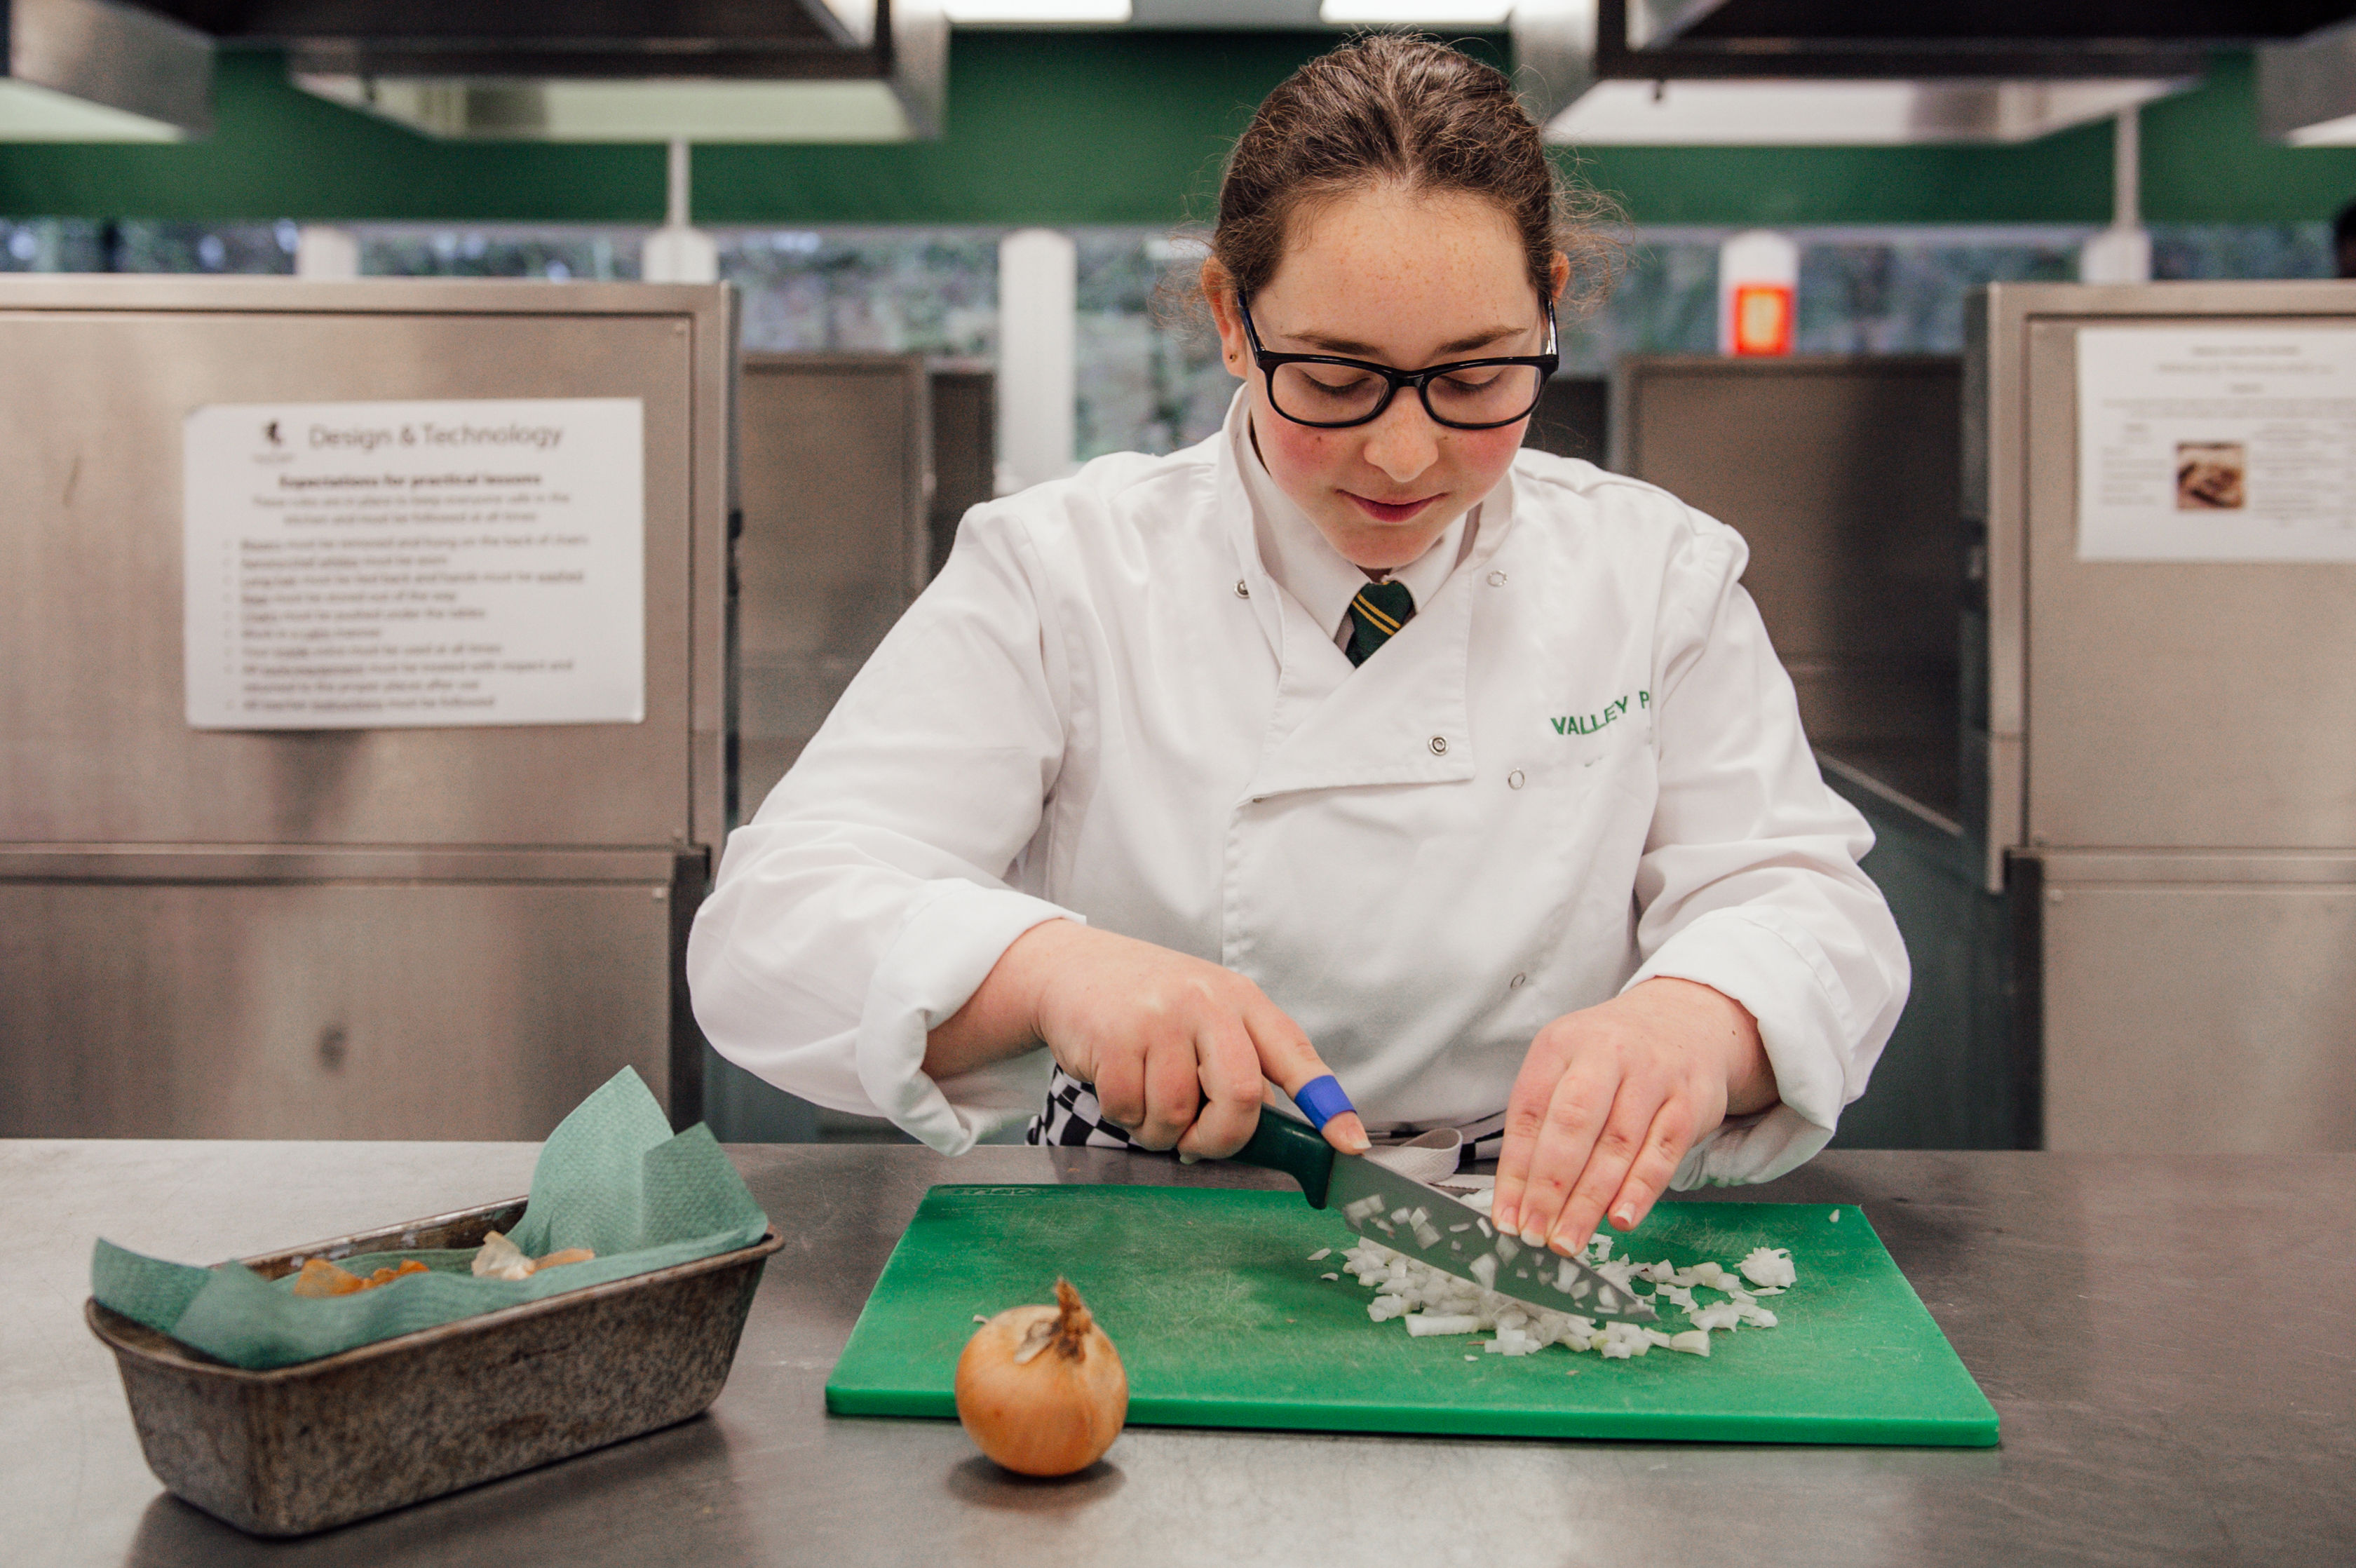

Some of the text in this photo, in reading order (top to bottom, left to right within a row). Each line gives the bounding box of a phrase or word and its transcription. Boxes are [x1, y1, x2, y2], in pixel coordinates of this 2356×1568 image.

[309, 421, 564, 452] Design & Technology
[1550, 695, 1628, 736] VALLEY
